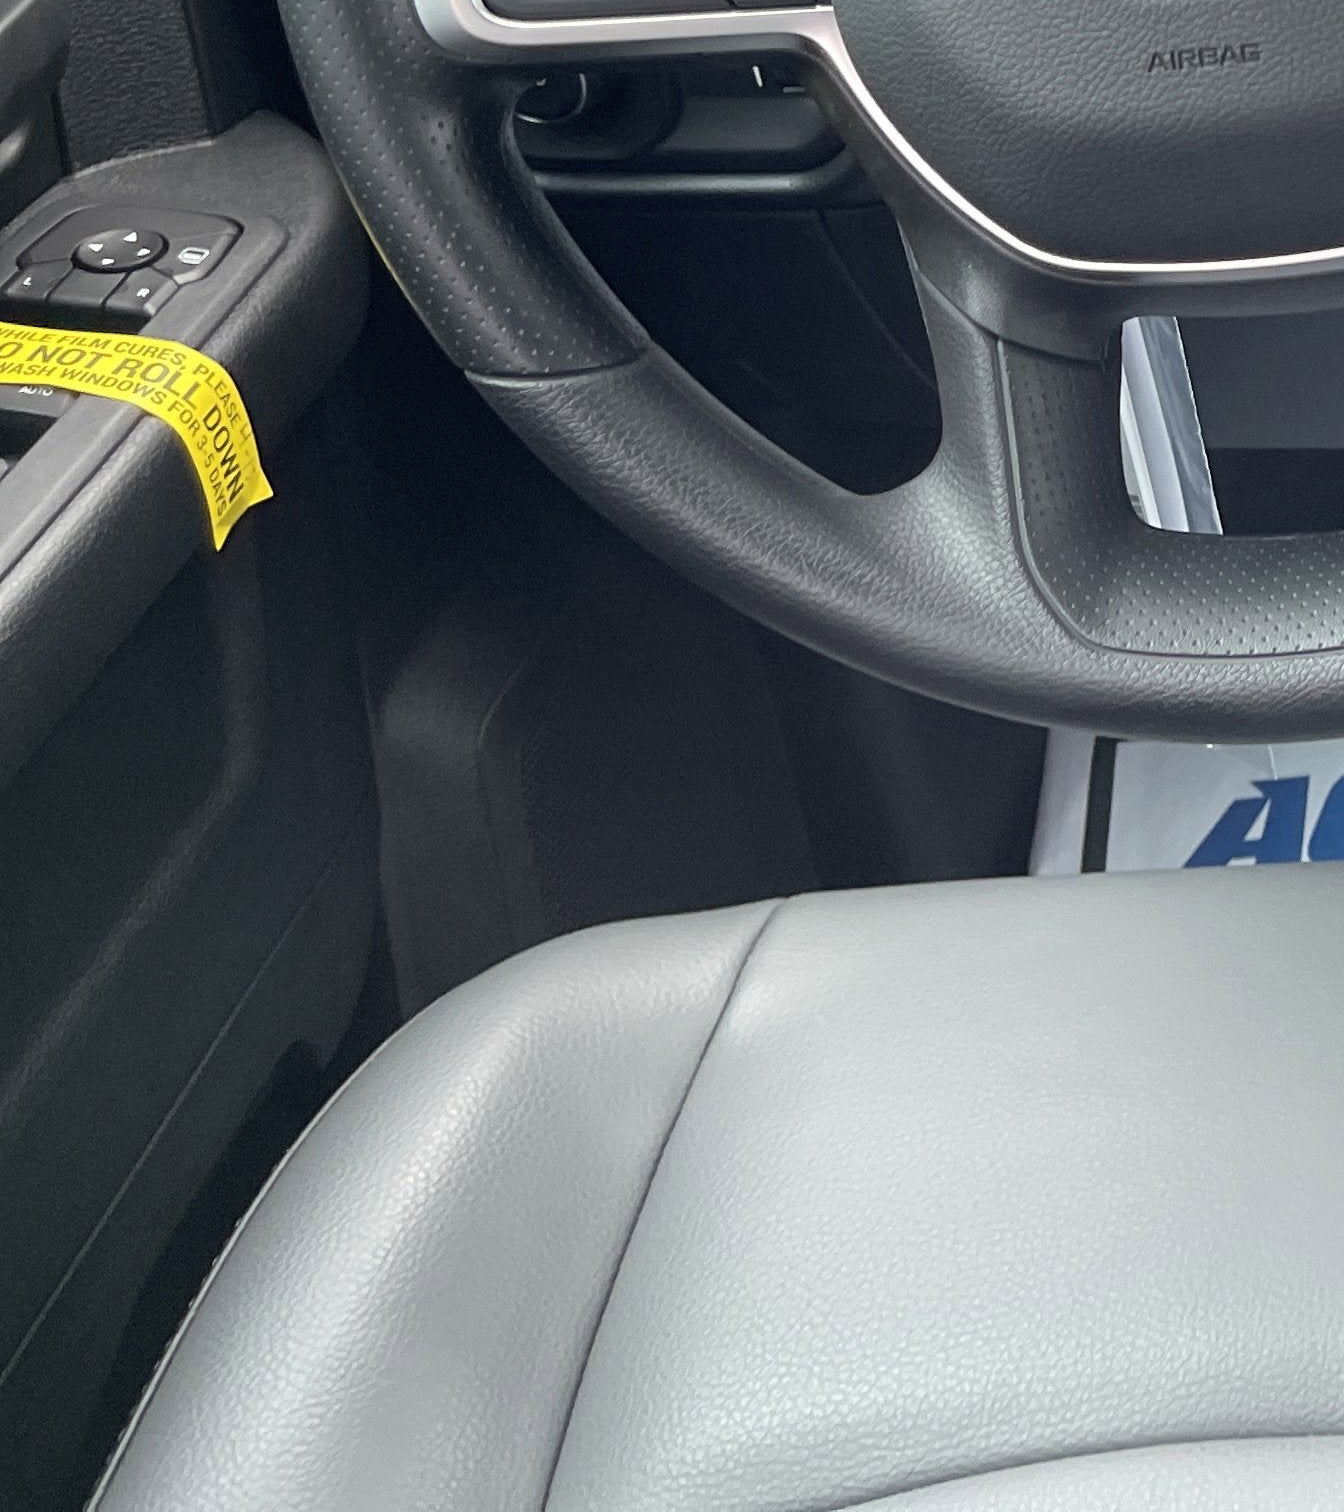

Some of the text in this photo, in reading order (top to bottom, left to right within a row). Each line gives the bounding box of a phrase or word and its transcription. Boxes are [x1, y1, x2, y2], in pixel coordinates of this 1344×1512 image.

[1146, 42, 1262, 74] AIRBAG
[25, 344, 113, 370] NOT
[111, 357, 202, 411] ROLL
[203, 404, 245, 504] DOWN
[56, 335, 112, 350] FILM
[113, 340, 188, 371] CURES,
[192, 363, 241, 429] PLEASE
[59, 367, 168, 406] WINDOWS
[167, 399, 201, 439] FOR
[196, 437, 215, 469] 3-5
[208, 468, 228, 517] DAYS
